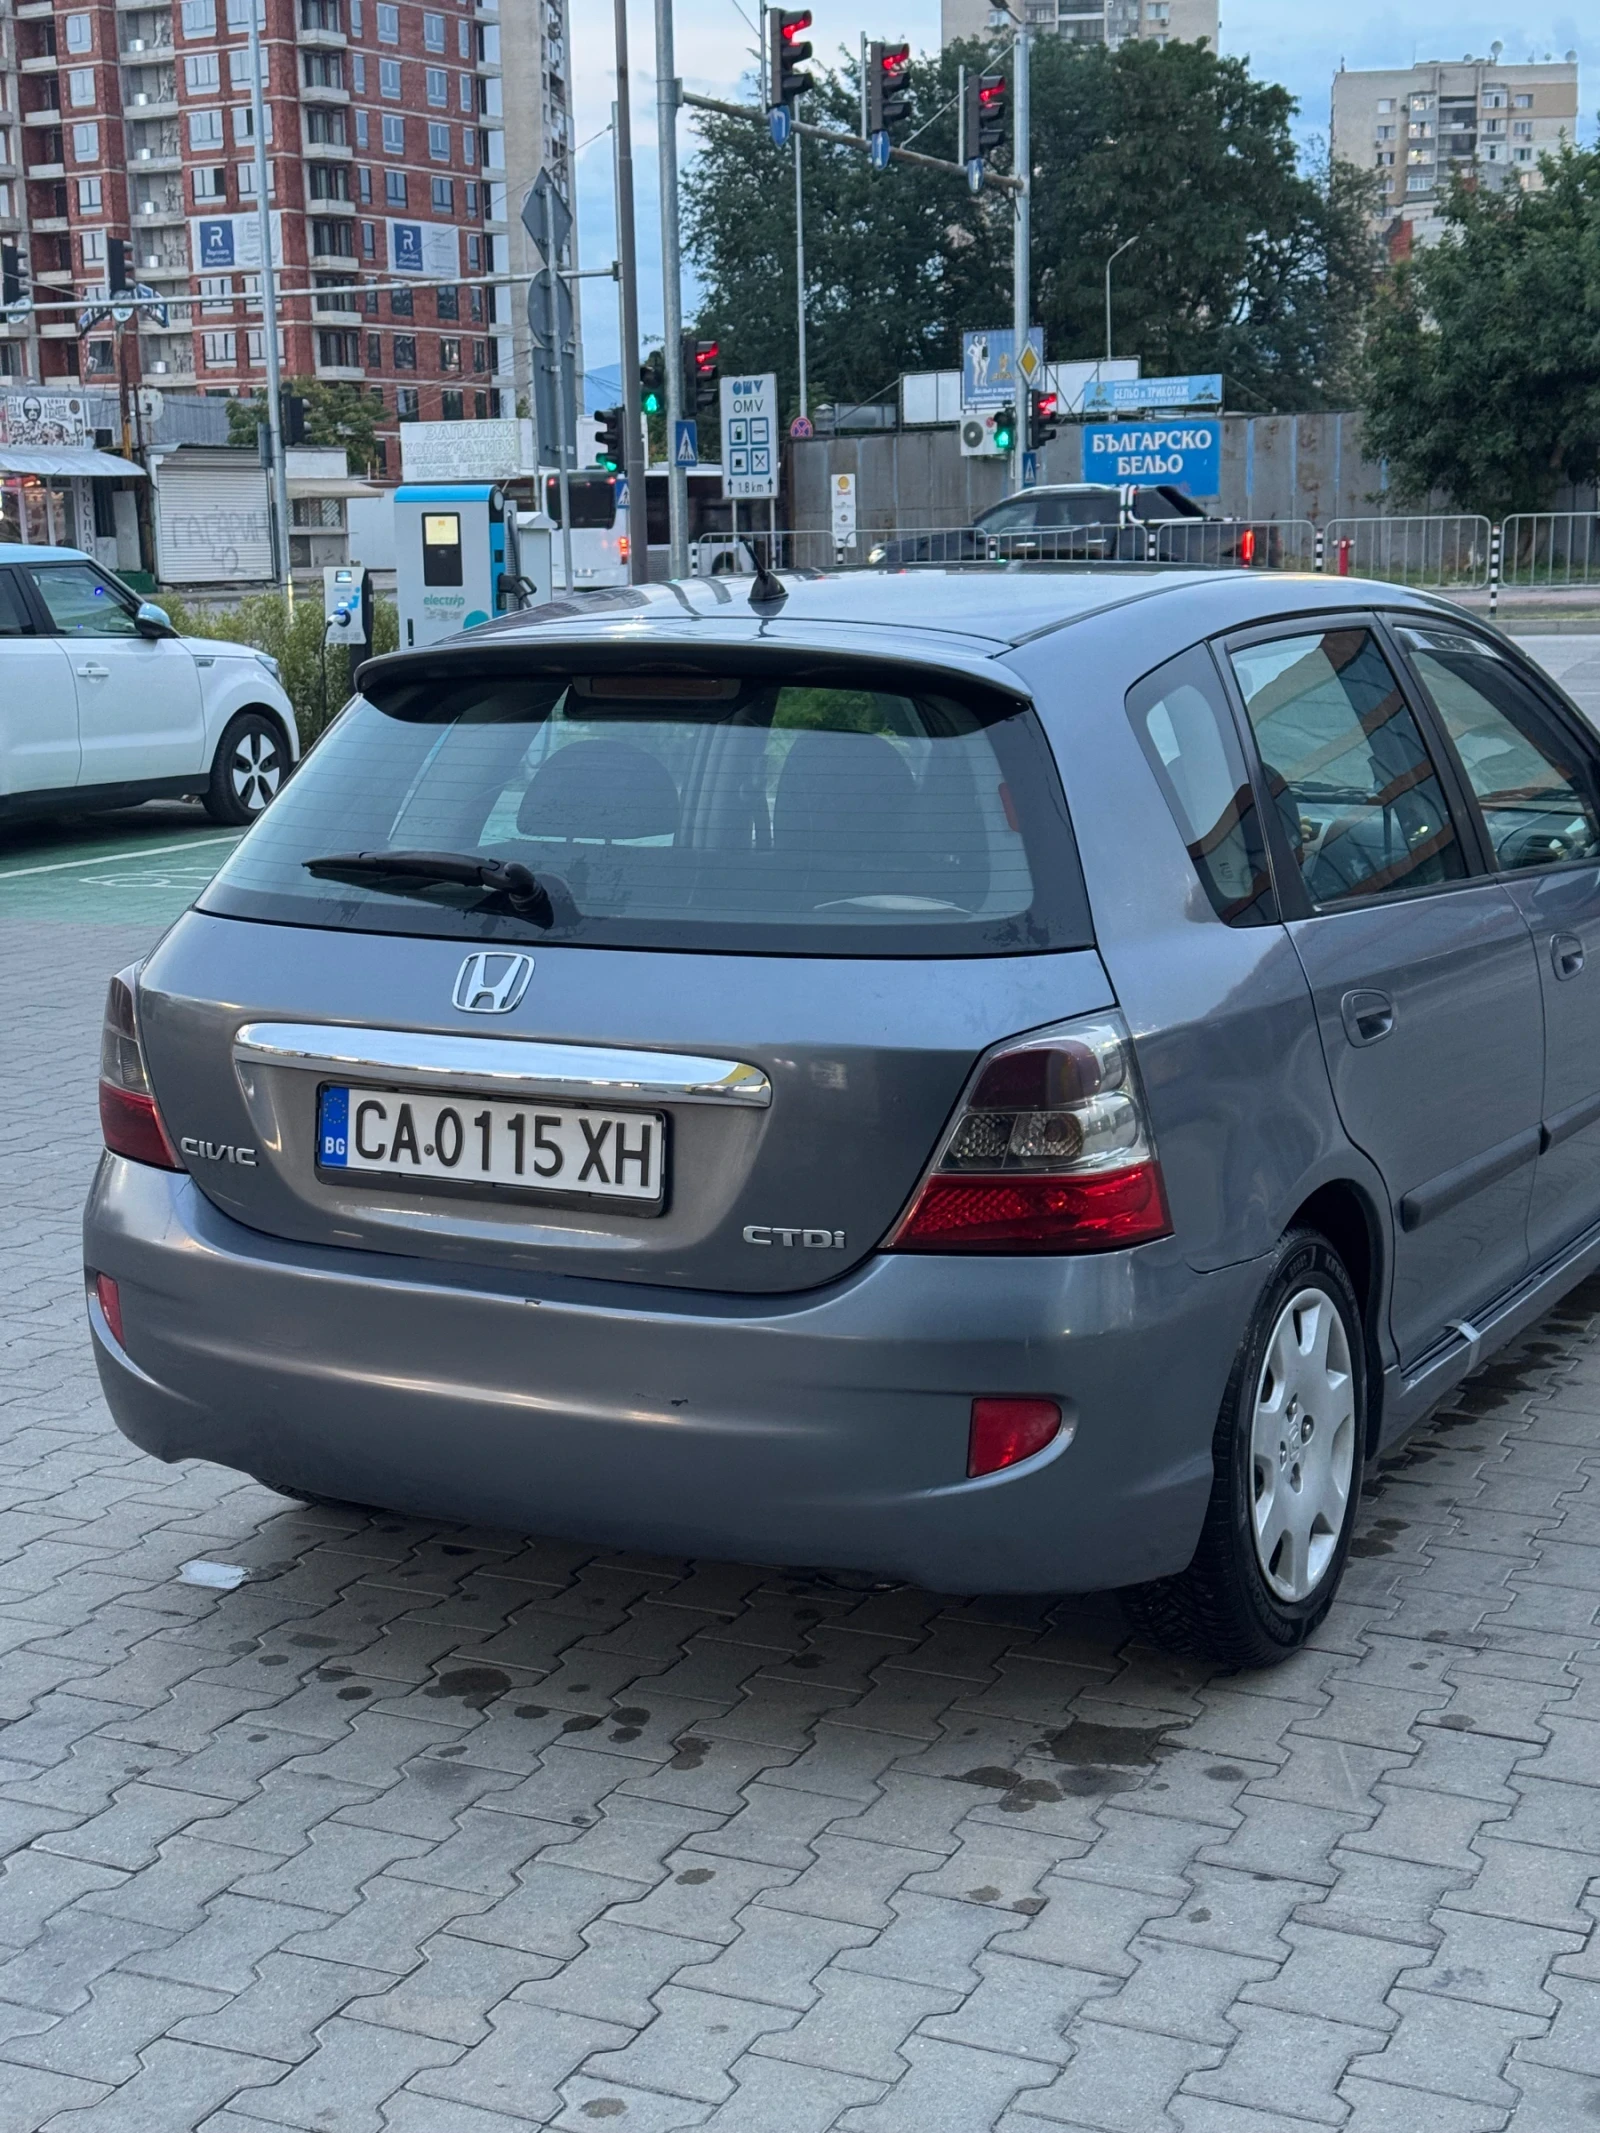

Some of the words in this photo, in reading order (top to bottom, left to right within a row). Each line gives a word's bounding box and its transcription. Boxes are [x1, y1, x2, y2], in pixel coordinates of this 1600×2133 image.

[1114, 387, 1140, 400] БЕЛЬО
[1147, 384, 1189, 398] ТРИКОТАЖ
[733, 399, 764, 413] OMV
[424, 421, 516, 440] ЗАПАЛКИ
[404, 439, 516, 456] КОНСУМАТИВИ
[1092, 429, 1212, 453] БЪЛГАРСКО
[1117, 454, 1183, 476] БЕЛЬО
[738, 482, 750, 493] 1.8
[751, 482, 764, 493] km
[423, 593, 465, 607] electrip
[181, 1136, 257, 1167] CIVIC
[325, 1137, 346, 1156] BG
[742, 1225, 846, 1249] CTDi
